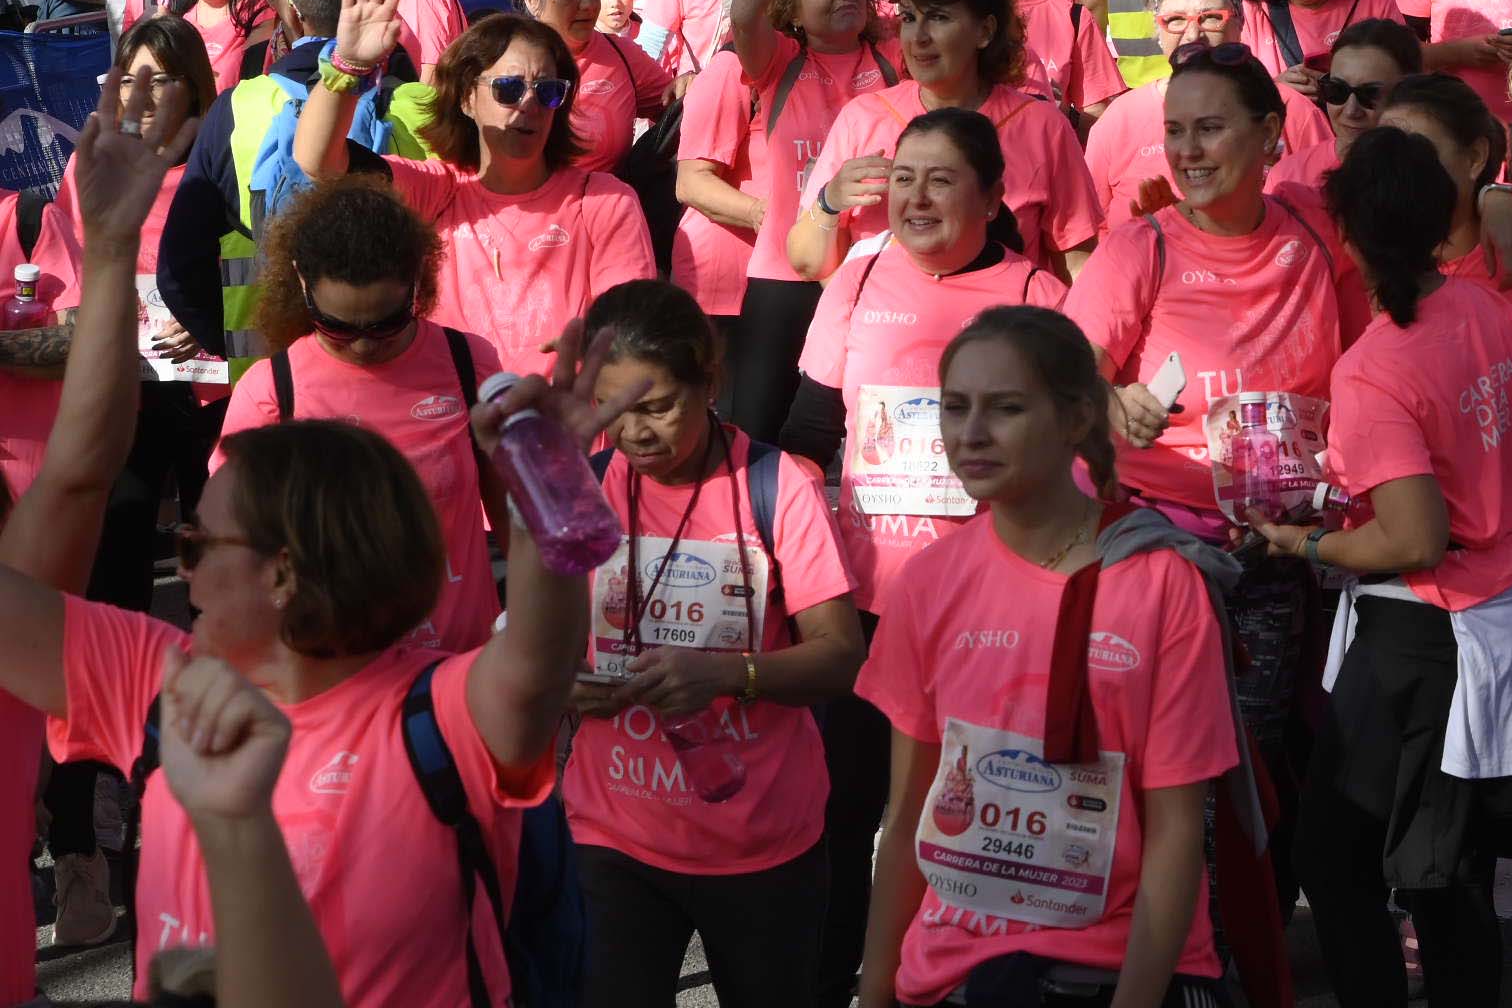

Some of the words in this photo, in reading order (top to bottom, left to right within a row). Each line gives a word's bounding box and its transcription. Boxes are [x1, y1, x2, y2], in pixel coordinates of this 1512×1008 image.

[864, 310, 917, 325] OYSHO
[1197, 369, 1243, 402] TU
[650, 599, 705, 622] 016
[654, 628, 696, 643] 17609
[608, 744, 695, 793] SUM
[984, 760, 1056, 787] ASTURIANA
[1068, 771, 1108, 785] SUMA
[980, 803, 1048, 835] 016
[981, 836, 1035, 860] 29446
[934, 850, 980, 870] CARRERA
[983, 861, 1000, 873] DE
[1001, 865, 1016, 876] LA
[1019, 868, 1058, 884] MUJER
[1061, 875, 1088, 889] 2023
[928, 872, 977, 898] OYSHO
[1025, 895, 1088, 917] Santander
